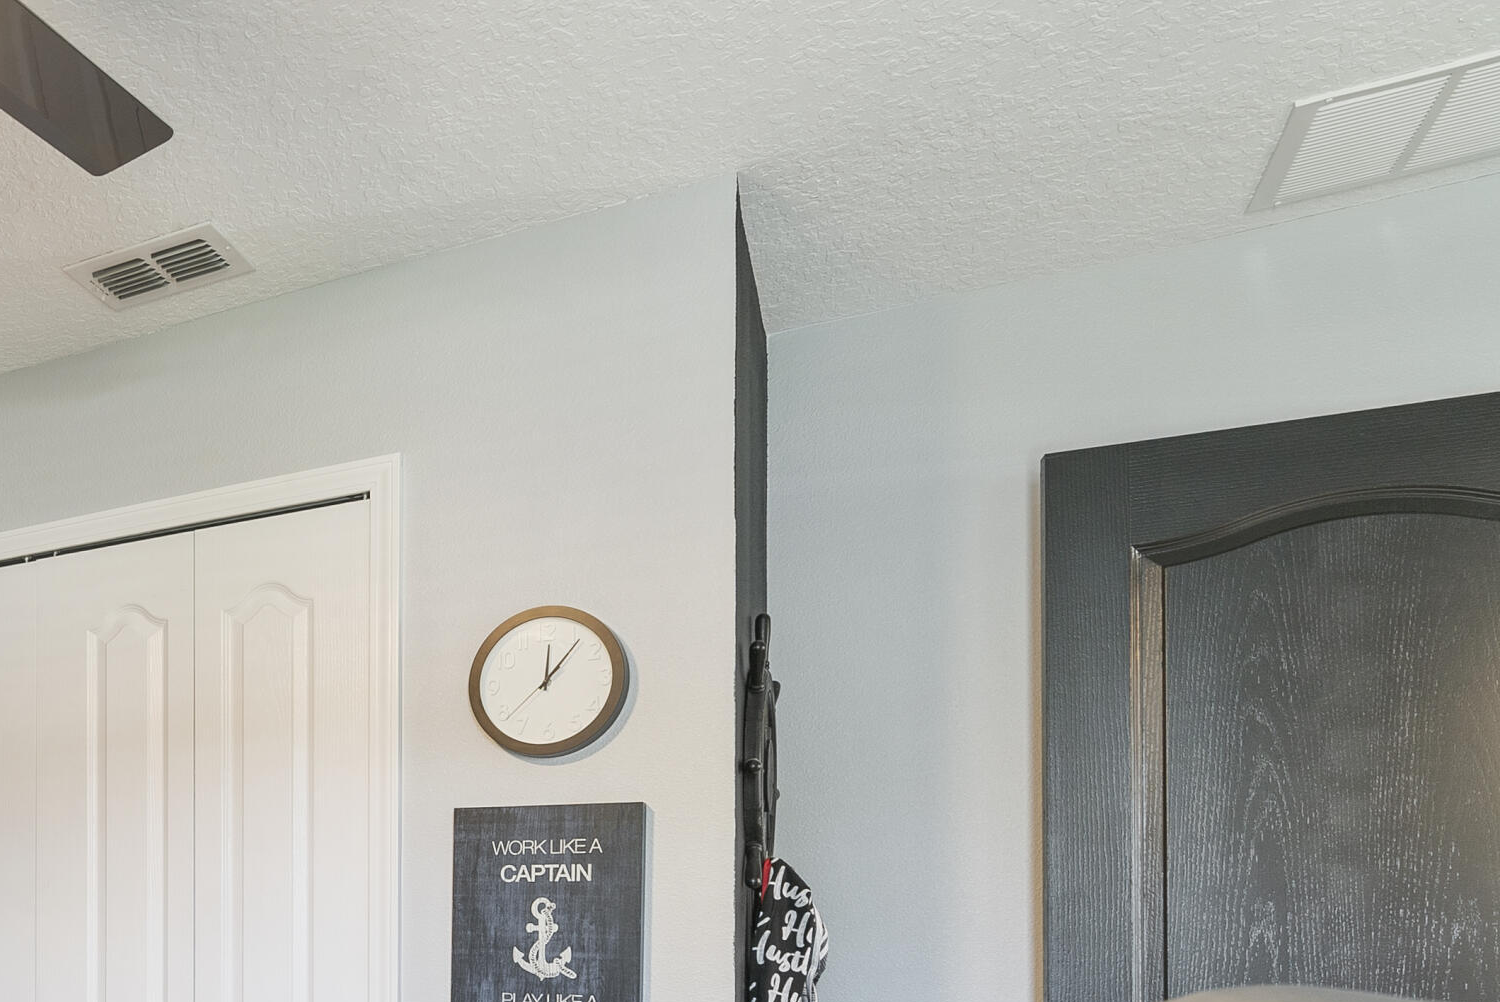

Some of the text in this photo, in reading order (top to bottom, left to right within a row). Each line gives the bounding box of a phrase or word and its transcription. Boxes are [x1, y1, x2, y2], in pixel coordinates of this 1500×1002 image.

[492, 838, 603, 856] WORK LIKE A
[500, 863, 592, 883] CAPTAIN
